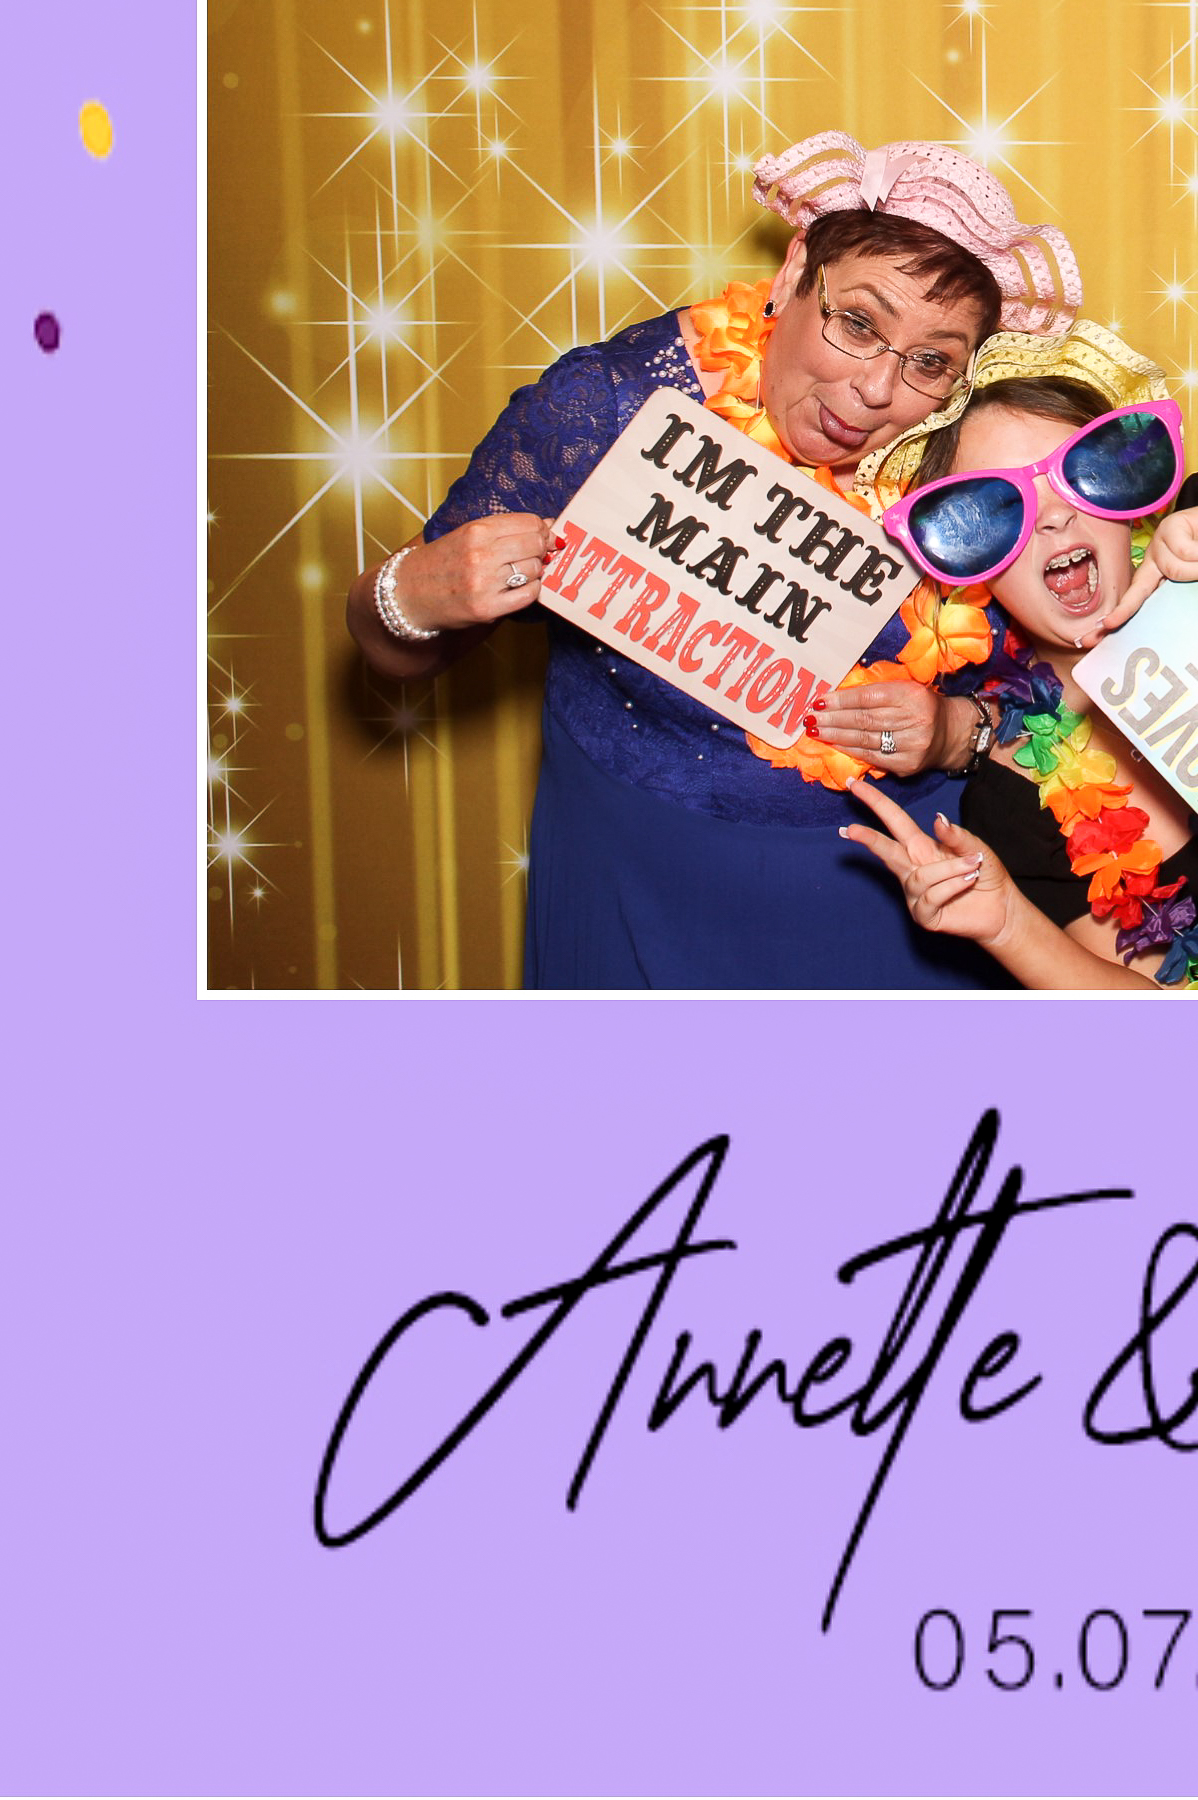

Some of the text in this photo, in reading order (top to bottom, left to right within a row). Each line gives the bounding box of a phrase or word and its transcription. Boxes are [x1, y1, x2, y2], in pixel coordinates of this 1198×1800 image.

[626, 492, 832, 644] MAIN
[640, 413, 904, 606] IM THE
[540, 520, 833, 738] ATTRACTION
